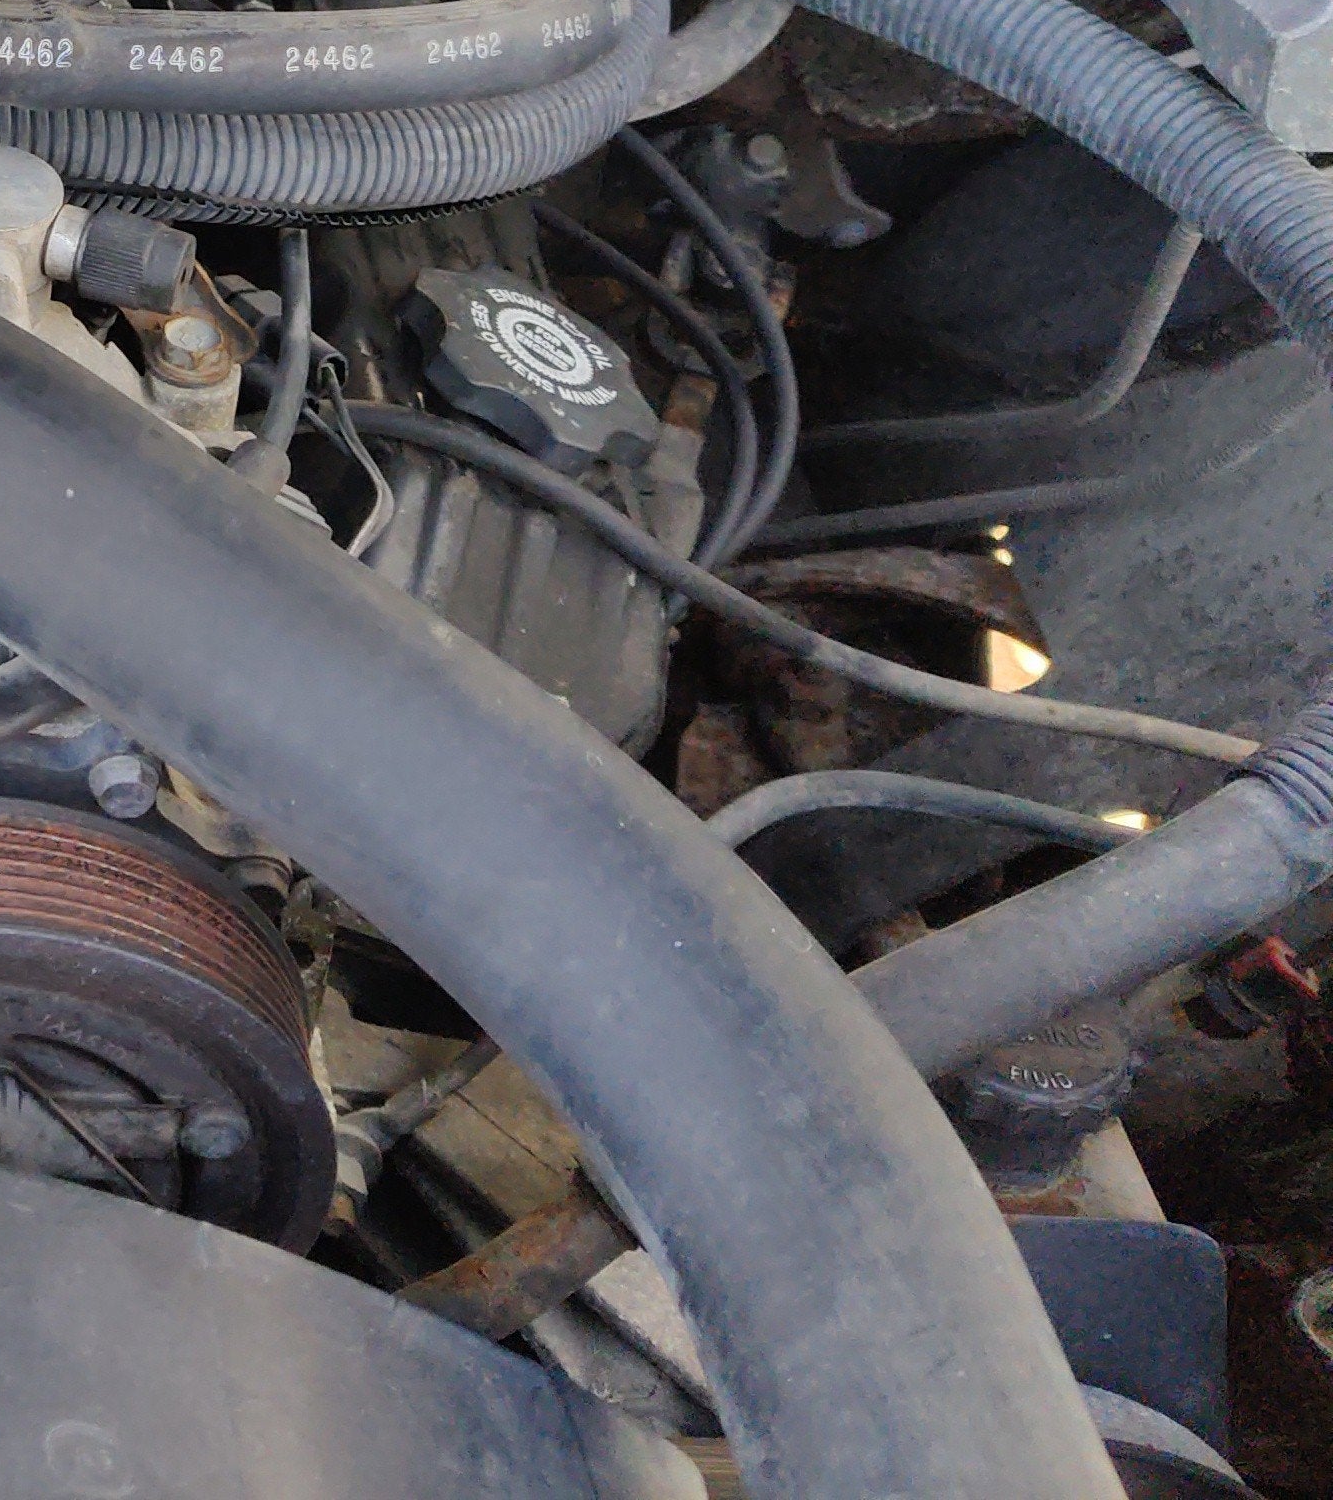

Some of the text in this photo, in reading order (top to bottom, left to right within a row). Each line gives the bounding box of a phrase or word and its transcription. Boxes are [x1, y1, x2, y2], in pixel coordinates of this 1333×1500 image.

[129, 45, 224, 73] 24462
[284, 43, 376, 74] 24462
[425, 31, 504, 65] 24462
[470, 300, 618, 407] SEE OWNERS MANUAL
[486, 288, 614, 371] ENGINE OIL
